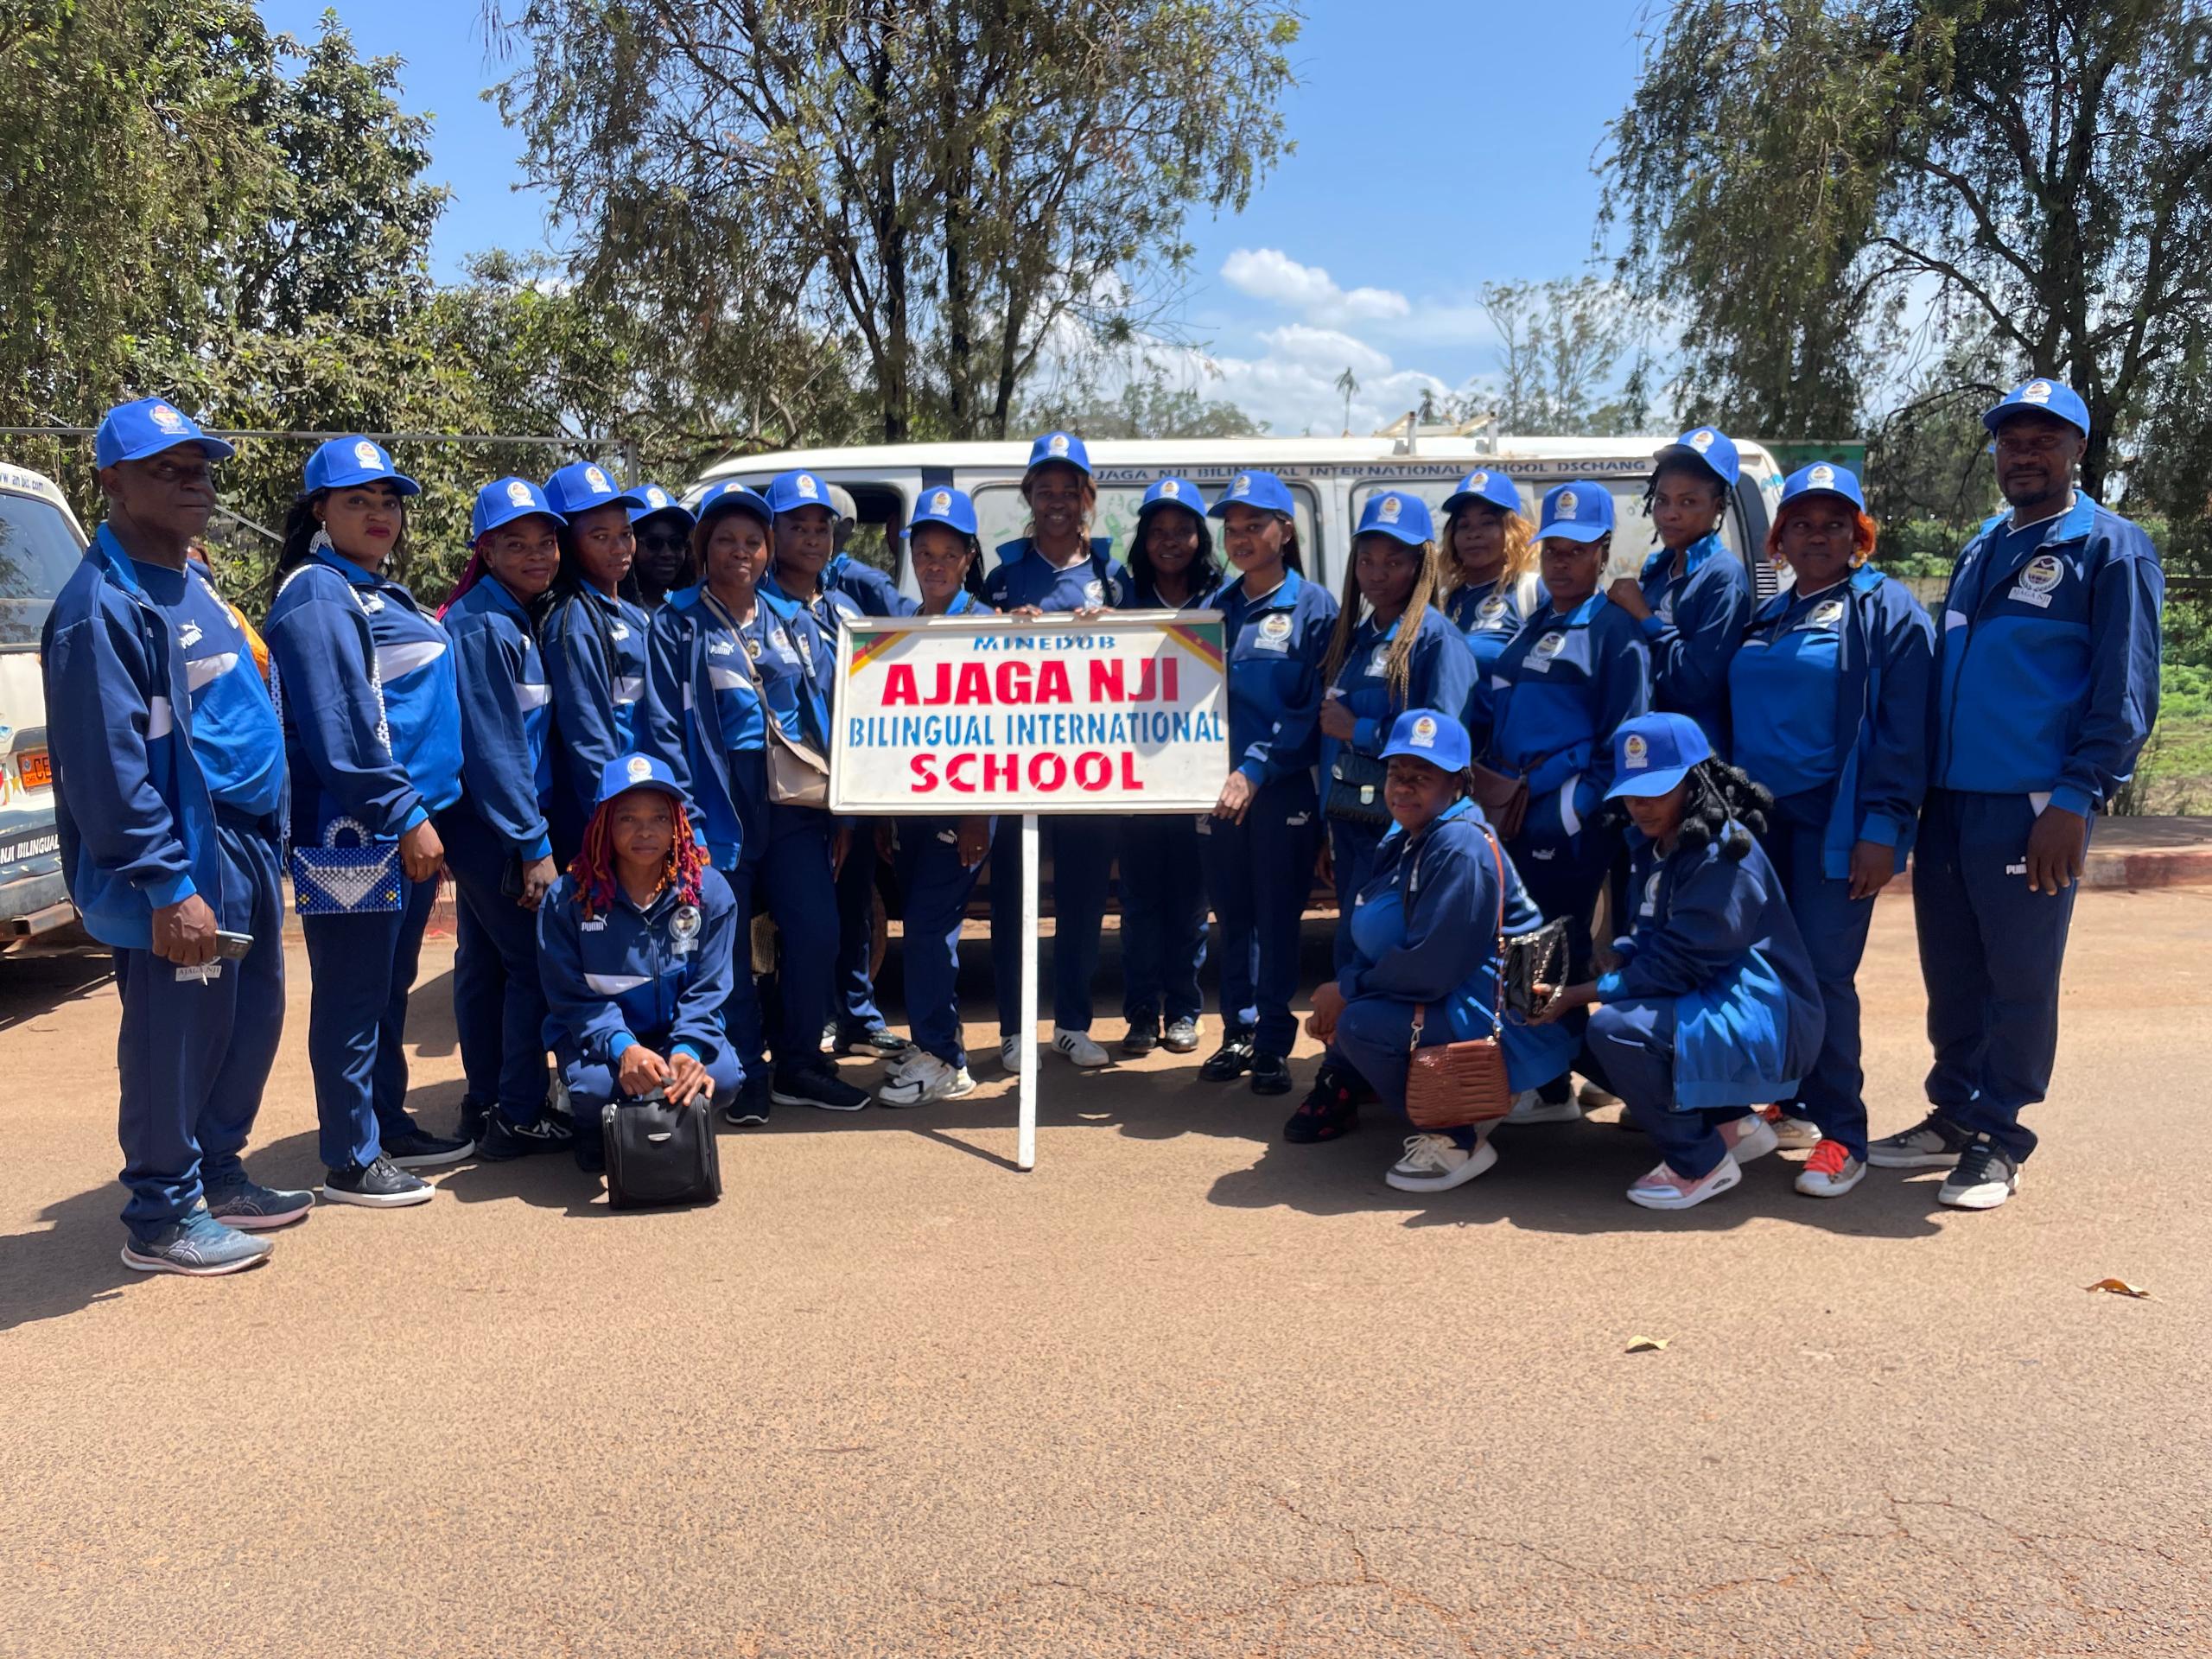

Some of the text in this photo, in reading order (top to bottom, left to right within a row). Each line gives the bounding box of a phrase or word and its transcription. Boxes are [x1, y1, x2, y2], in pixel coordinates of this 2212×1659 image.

[1097, 468, 1148, 480] JAGA
[1309, 464, 1465, 476] INTERNATIONAL
[1557, 460, 1646, 472] DSCHANG
[973, 635, 1116, 652] MINEDUB
[881, 658, 1179, 705] AJAGA NJI
[849, 710, 1224, 747] BILINGUAL INTERNATIONAL
[910, 752, 1144, 792] SCHOOL
[17, 834, 60, 859] BILINGUAL
[2005, 864, 2027, 875] PUM
[581, 920, 605, 932] PUMA
